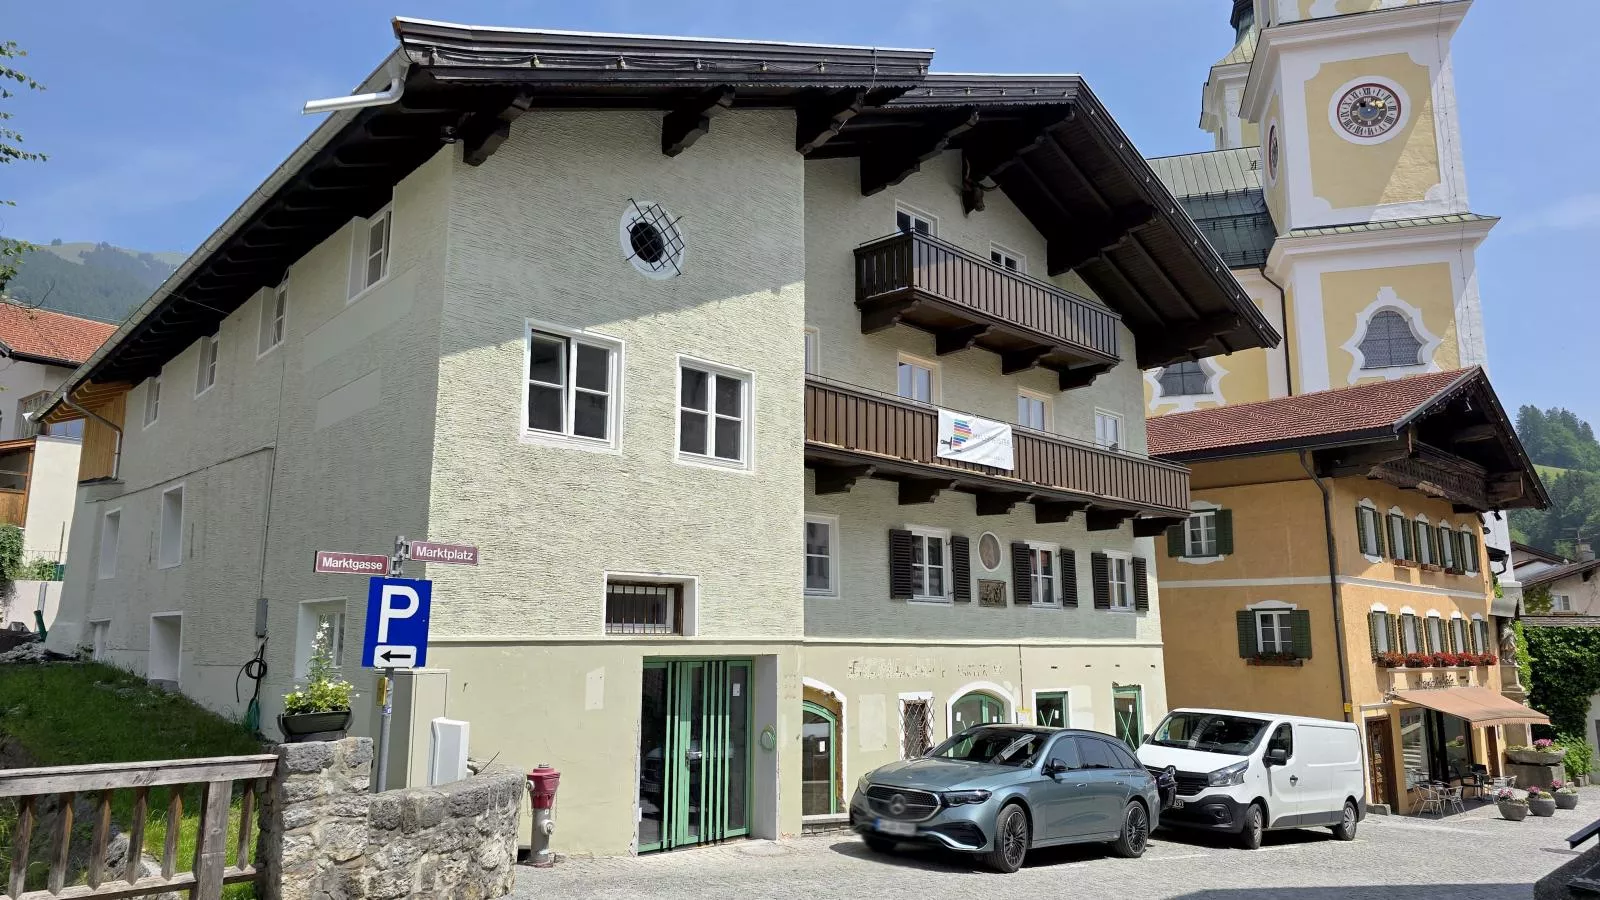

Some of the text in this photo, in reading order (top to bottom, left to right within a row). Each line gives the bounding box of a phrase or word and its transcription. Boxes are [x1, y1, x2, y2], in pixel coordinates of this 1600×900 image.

[416, 545, 474, 561] Marktplatz
[322, 557, 383, 571] Marktgasse
[377, 584, 420, 643] P
